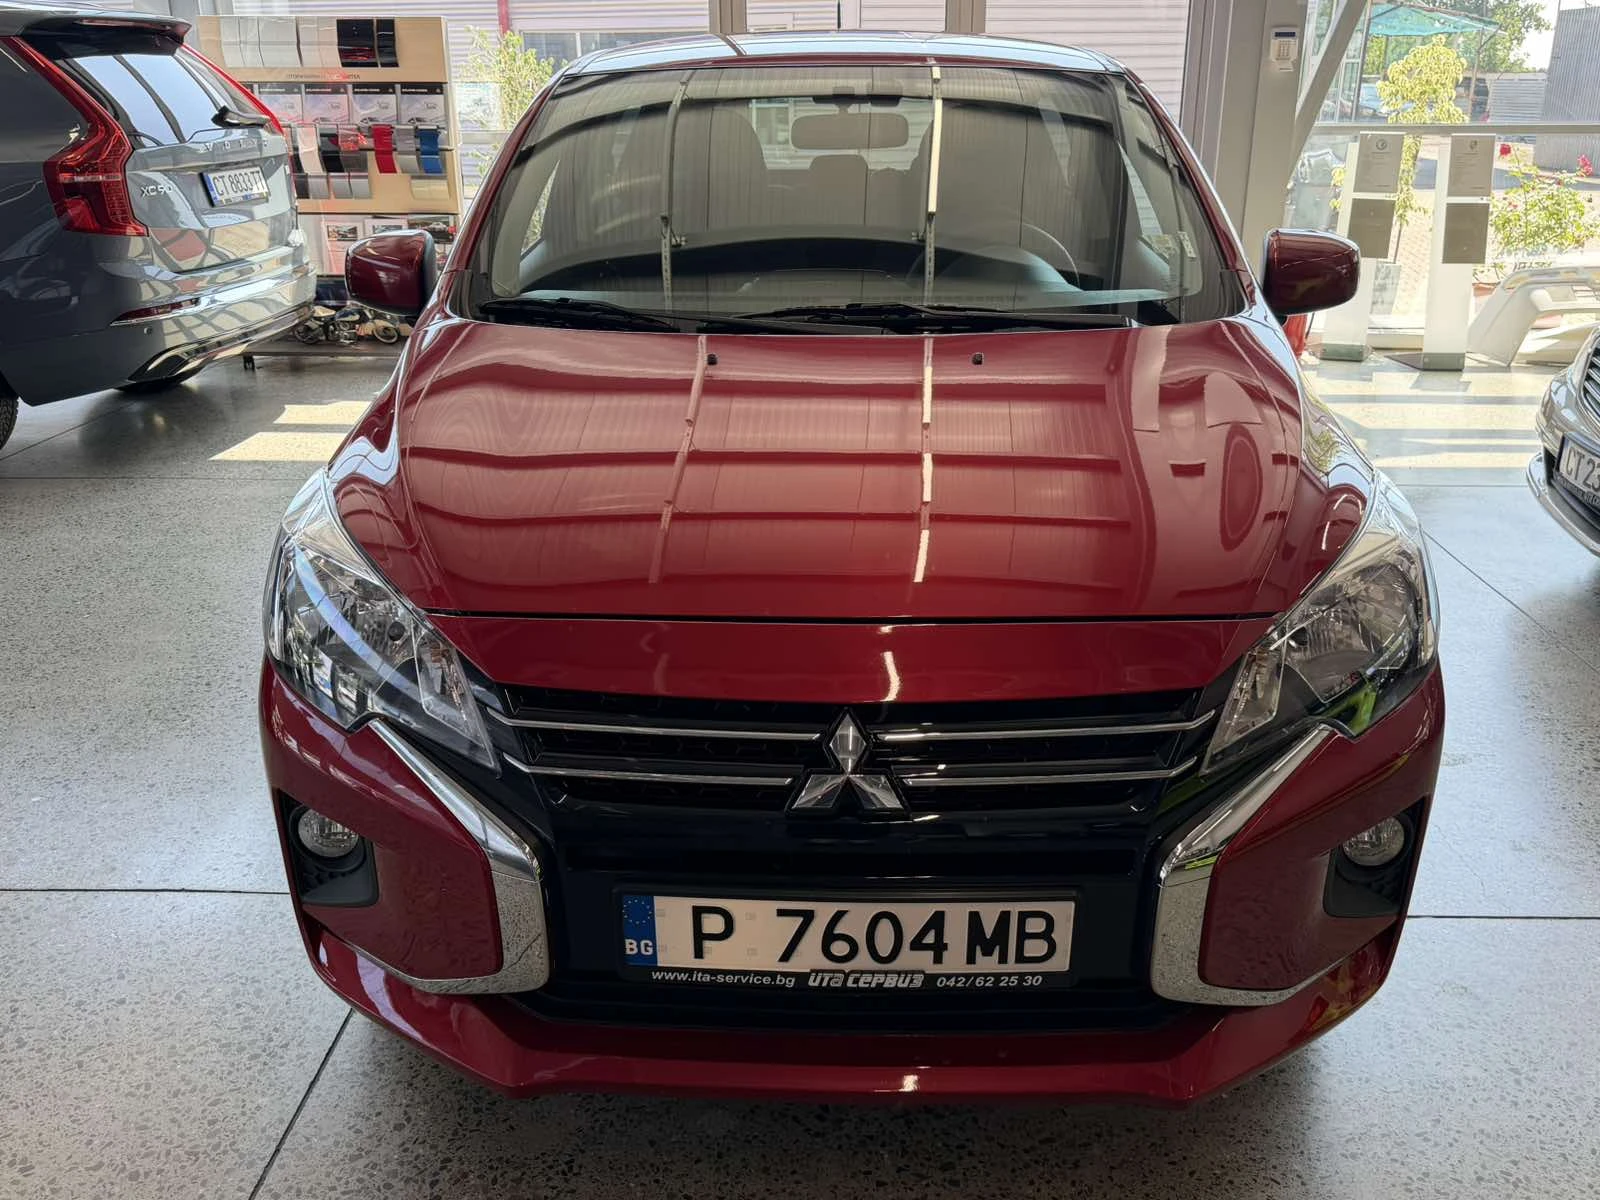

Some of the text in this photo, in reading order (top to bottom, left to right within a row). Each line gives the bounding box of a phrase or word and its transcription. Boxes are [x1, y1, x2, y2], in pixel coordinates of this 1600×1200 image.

[213, 175, 229, 196] CT
[228, 173, 253, 193] 8833
[1566, 446, 1585, 480] CT
[692, 904, 1057, 966] P 7604 MB
[624, 938, 654, 955] BG
[652, 969, 795, 988] www.ita-service.bg
[936, 975, 1043, 988] 042/62 25 30
